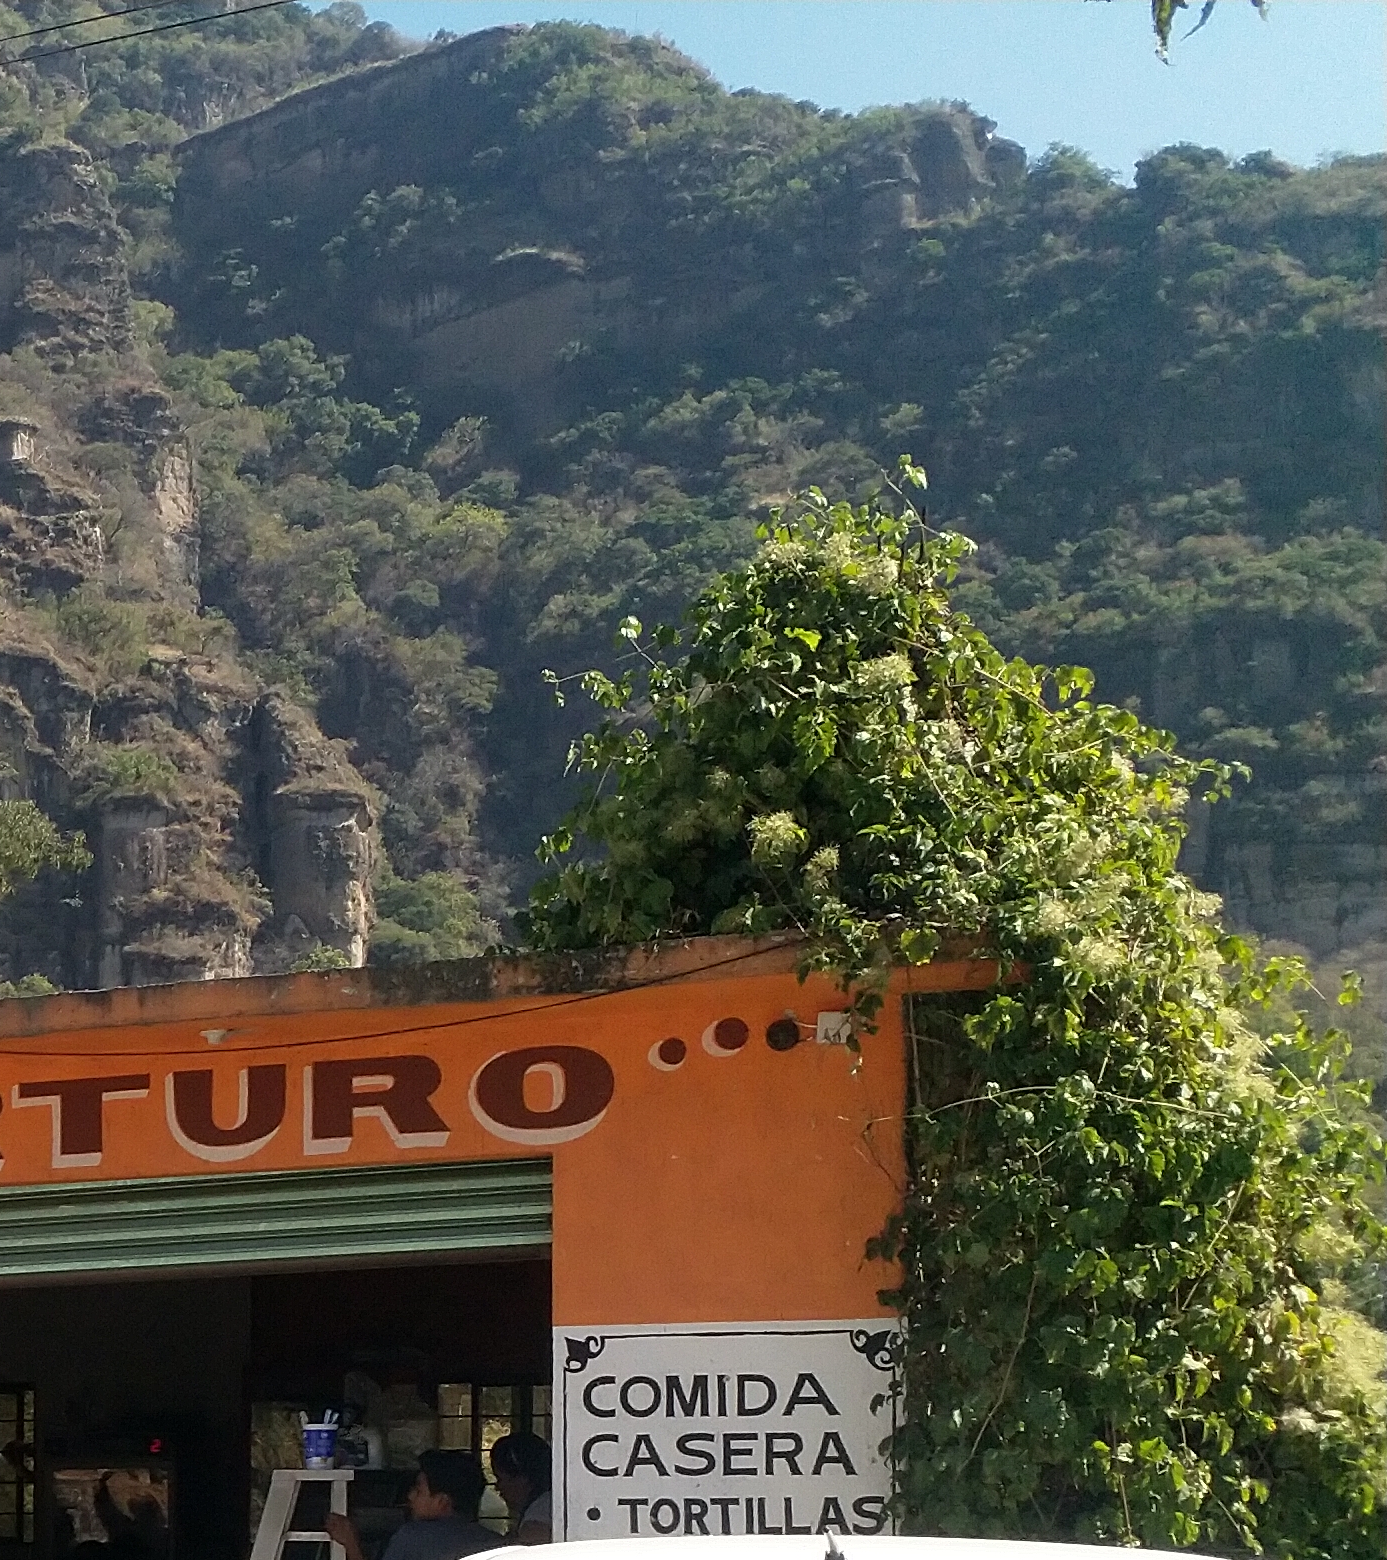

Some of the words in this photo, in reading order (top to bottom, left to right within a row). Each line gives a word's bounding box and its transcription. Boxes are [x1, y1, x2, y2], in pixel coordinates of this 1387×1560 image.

[582, 1372, 841, 1418] COMIDA
[582, 1431, 858, 1477] CASERA
[617, 1496, 887, 1535] TORTILLAS
